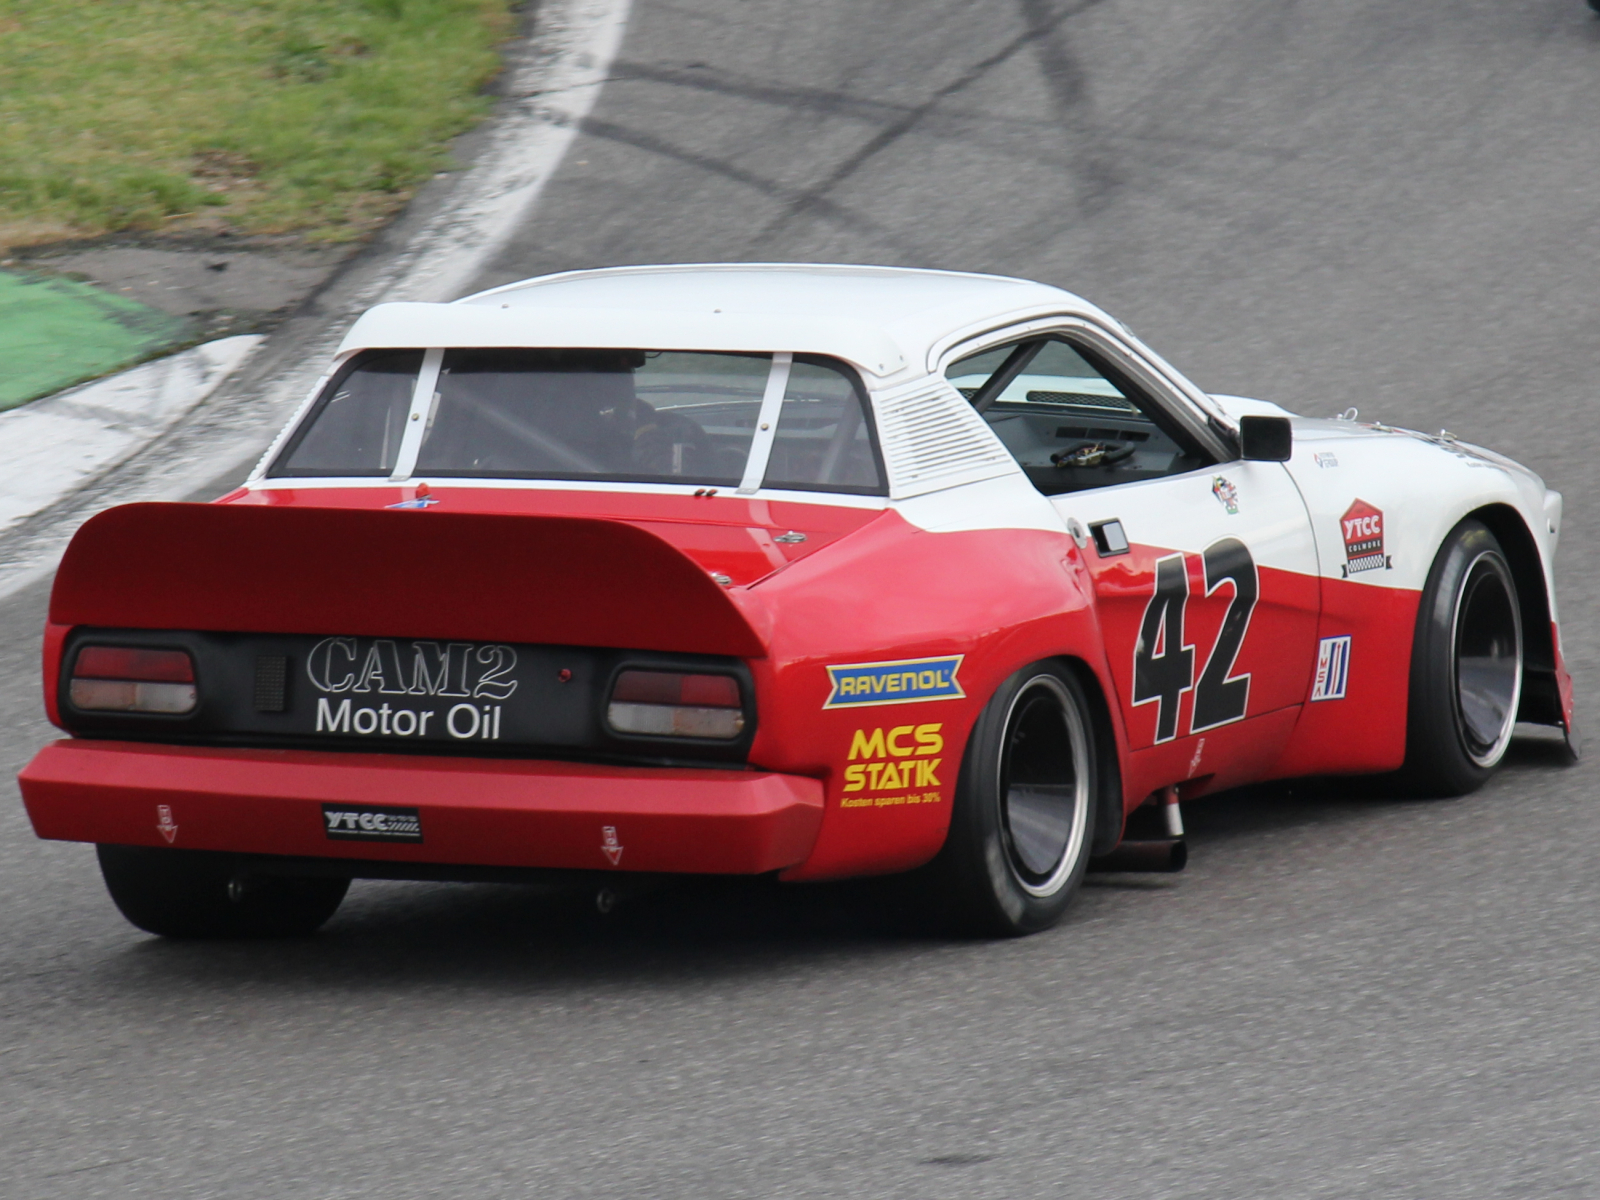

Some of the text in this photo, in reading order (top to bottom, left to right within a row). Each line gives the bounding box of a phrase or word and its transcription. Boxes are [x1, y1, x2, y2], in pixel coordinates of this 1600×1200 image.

[1344, 515, 1381, 540] YTCC
[1132, 535, 1259, 745] 42
[307, 637, 518, 700] CAM2
[840, 670, 950, 696] RAVENOL
[1314, 643, 1328, 697] IMSA
[316, 698, 501, 739] Motor Oil
[847, 723, 944, 760] MCS
[843, 758, 942, 792] STATIK
[324, 811, 389, 830] YTCC
